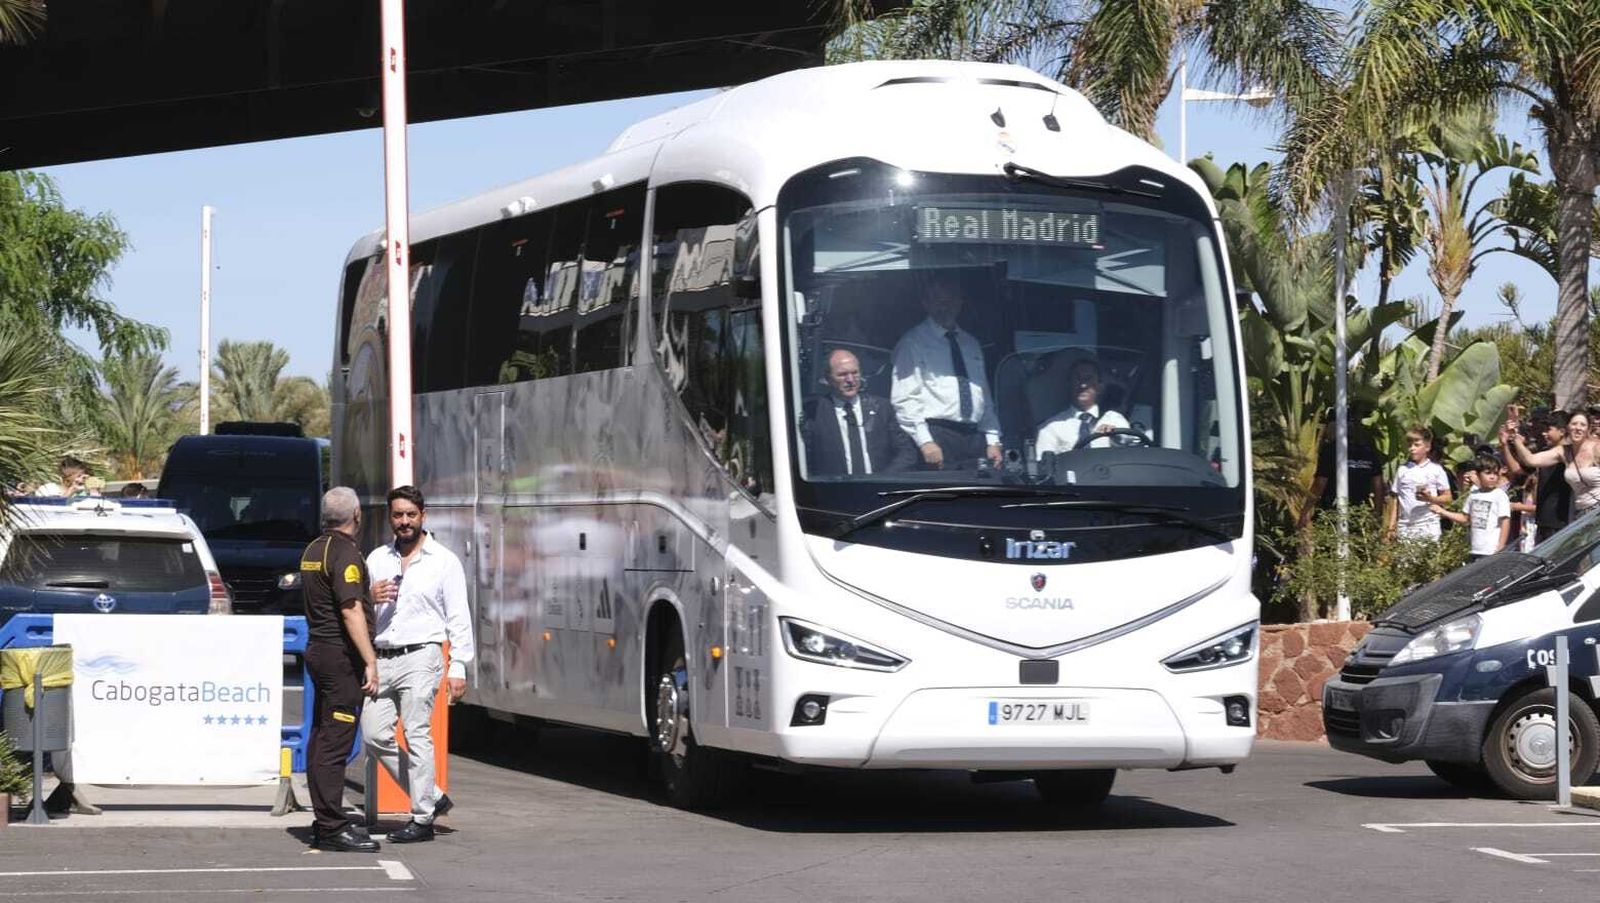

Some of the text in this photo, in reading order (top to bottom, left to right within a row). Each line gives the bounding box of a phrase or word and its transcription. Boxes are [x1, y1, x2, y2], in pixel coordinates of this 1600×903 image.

[924, 207, 1097, 243] Real Madrid
[1006, 538, 1076, 558] Irizar
[1006, 597, 1074, 609] SCANIA
[92, 680, 270, 706] CabogataBeach
[1002, 704, 1086, 721] 9727 MJL
